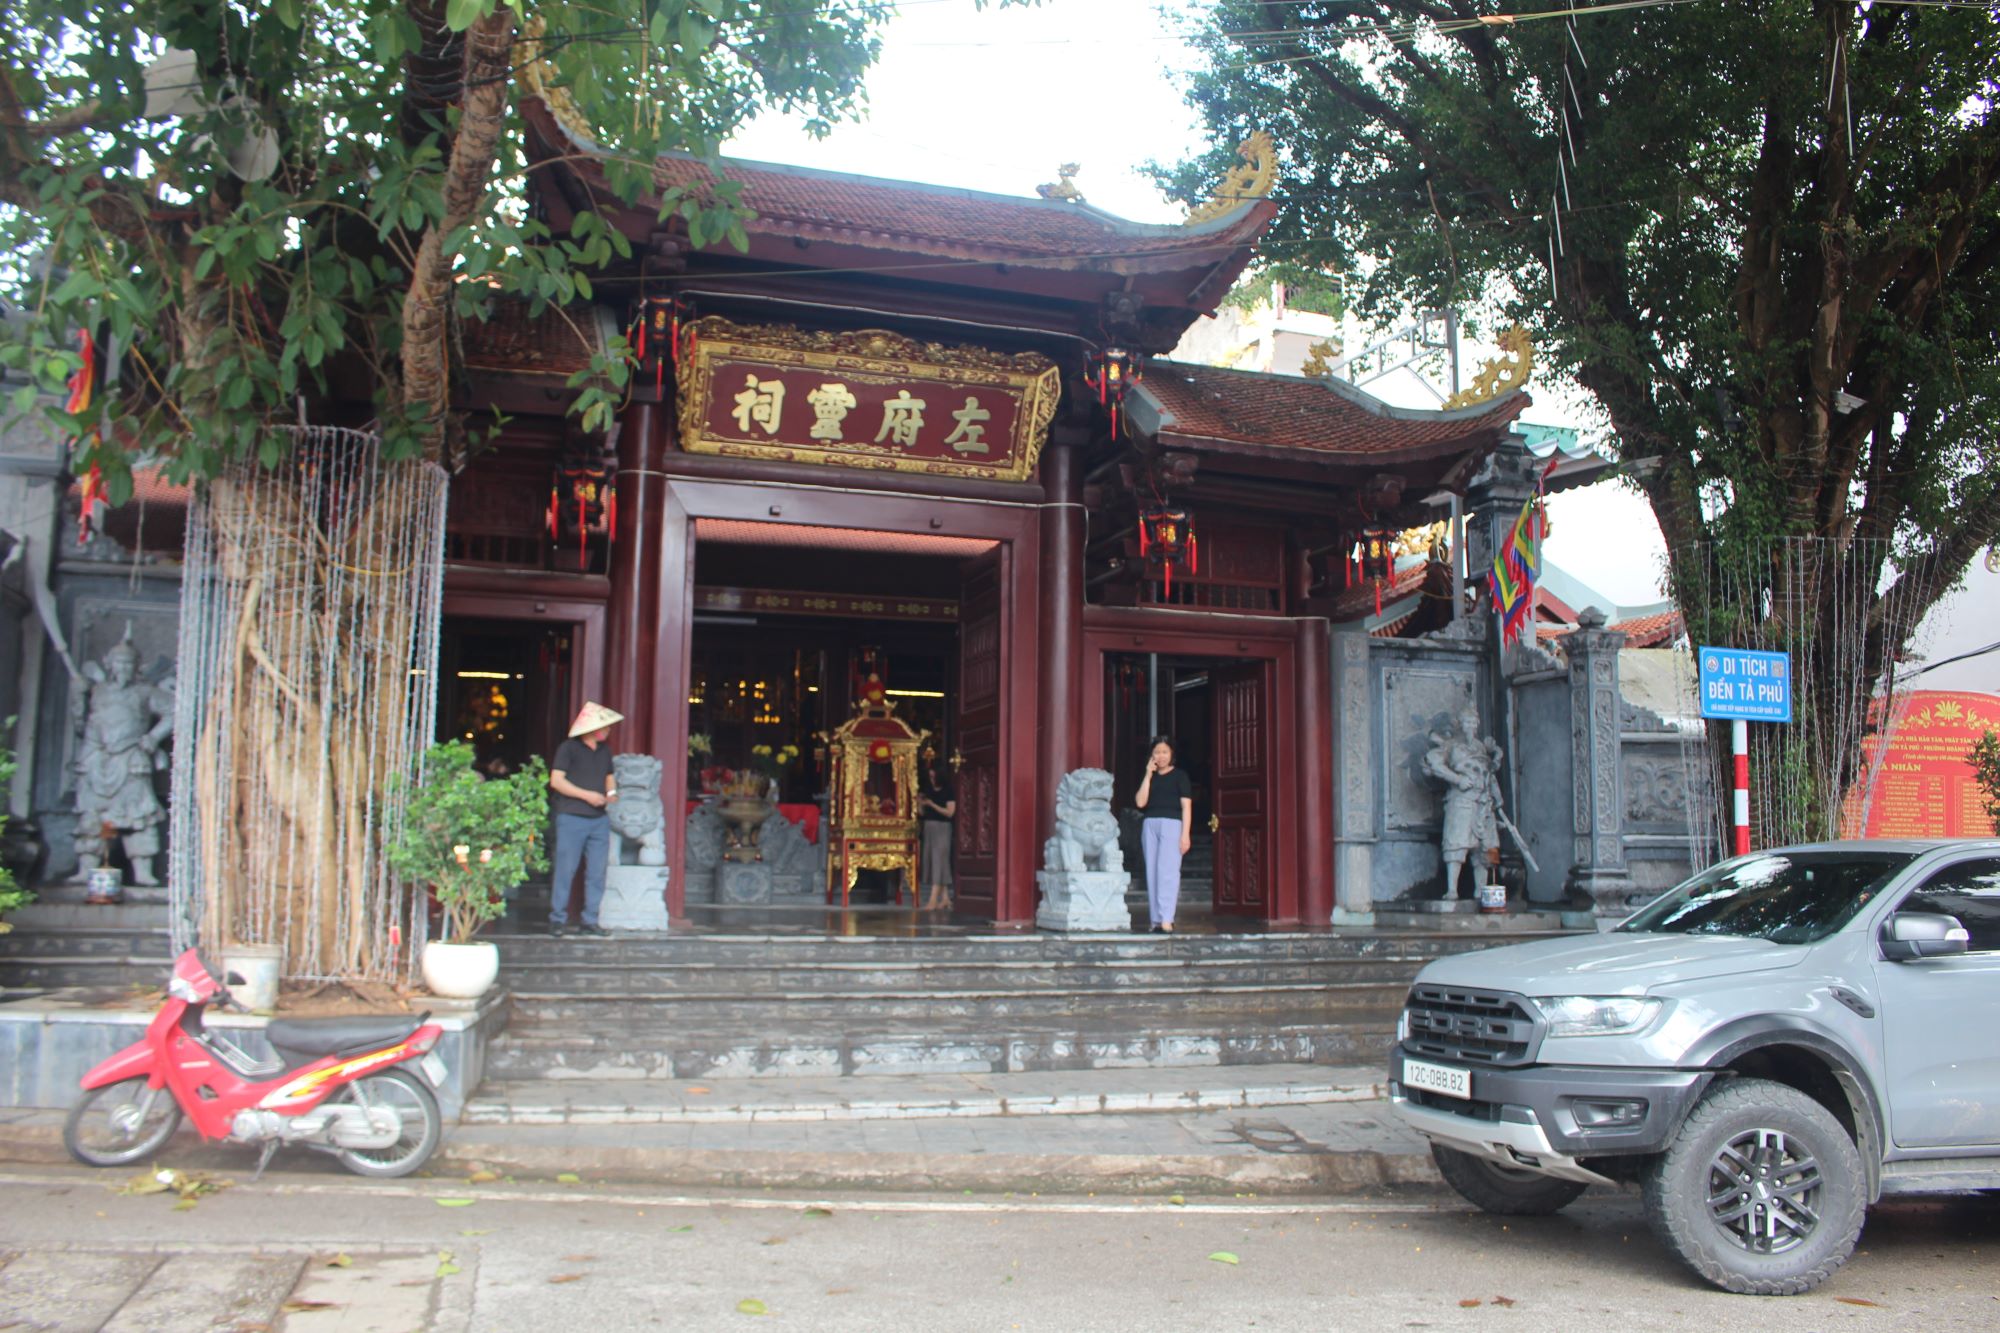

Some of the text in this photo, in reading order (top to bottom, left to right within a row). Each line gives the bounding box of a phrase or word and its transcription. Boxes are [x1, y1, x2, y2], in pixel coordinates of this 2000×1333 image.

[1723, 655, 1767, 676] DI TÍCH
[1709, 677, 1733, 700] ĐỀN
[1758, 680, 1783, 702] PHỦ
[1410, 1065, 1463, 1091] 12C-088.82
